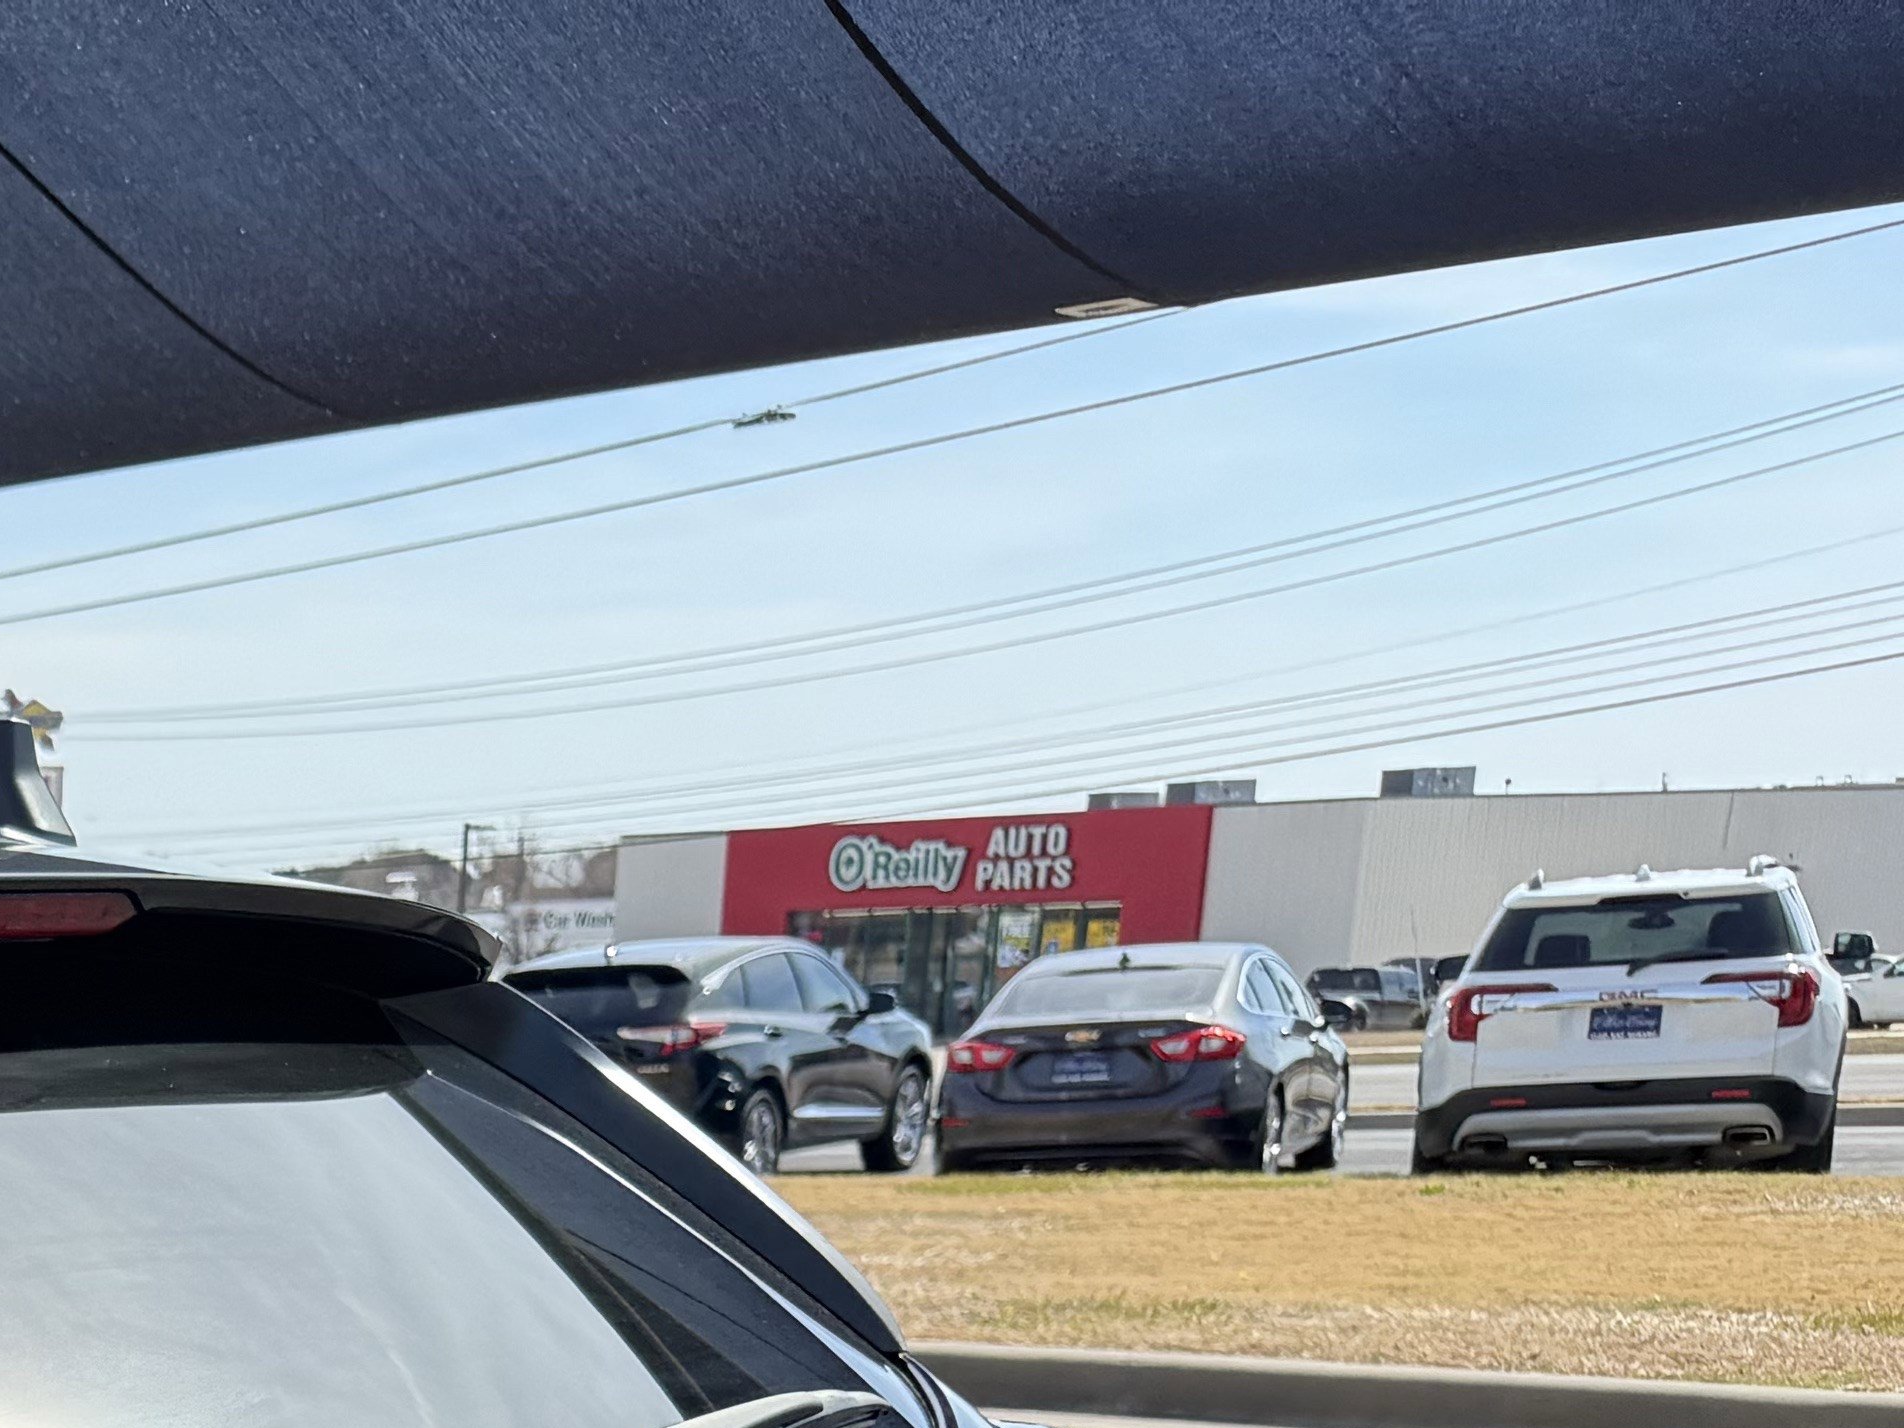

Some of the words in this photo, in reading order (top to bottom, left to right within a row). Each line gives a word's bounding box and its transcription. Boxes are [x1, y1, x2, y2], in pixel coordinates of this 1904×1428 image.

[987, 824, 1068, 858] AUTO
[831, 837, 967, 892] O'Reilly
[976, 857, 1073, 892] PARTS
[544, 910, 568, 929] Car
